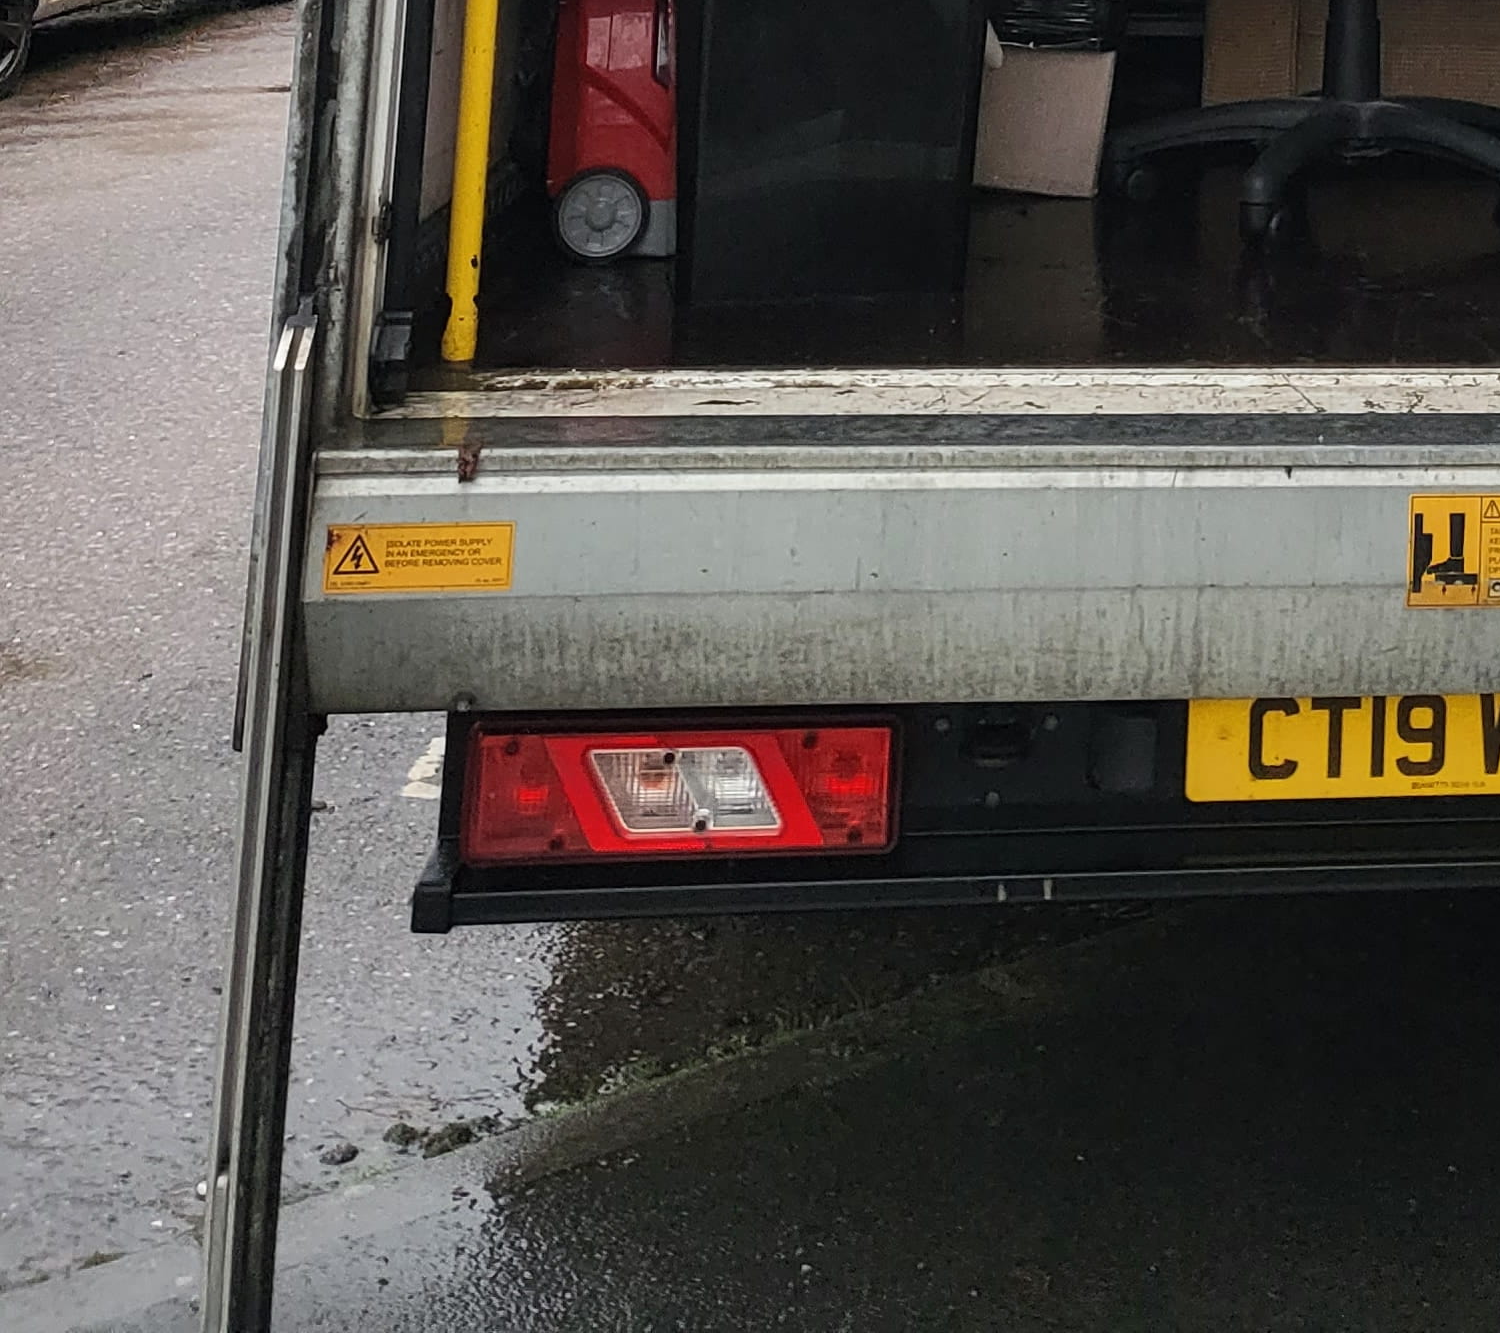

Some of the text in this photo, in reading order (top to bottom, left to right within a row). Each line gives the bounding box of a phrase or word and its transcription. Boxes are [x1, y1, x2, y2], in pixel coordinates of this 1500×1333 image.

[424, 538, 457, 547] POWER
[459, 537, 493, 546] SUPPLY
[410, 548, 465, 557] EMERGENCY
[384, 557, 502, 568] BEFORE REMOVING COVER
[1248, 694, 1447, 781] CT19
